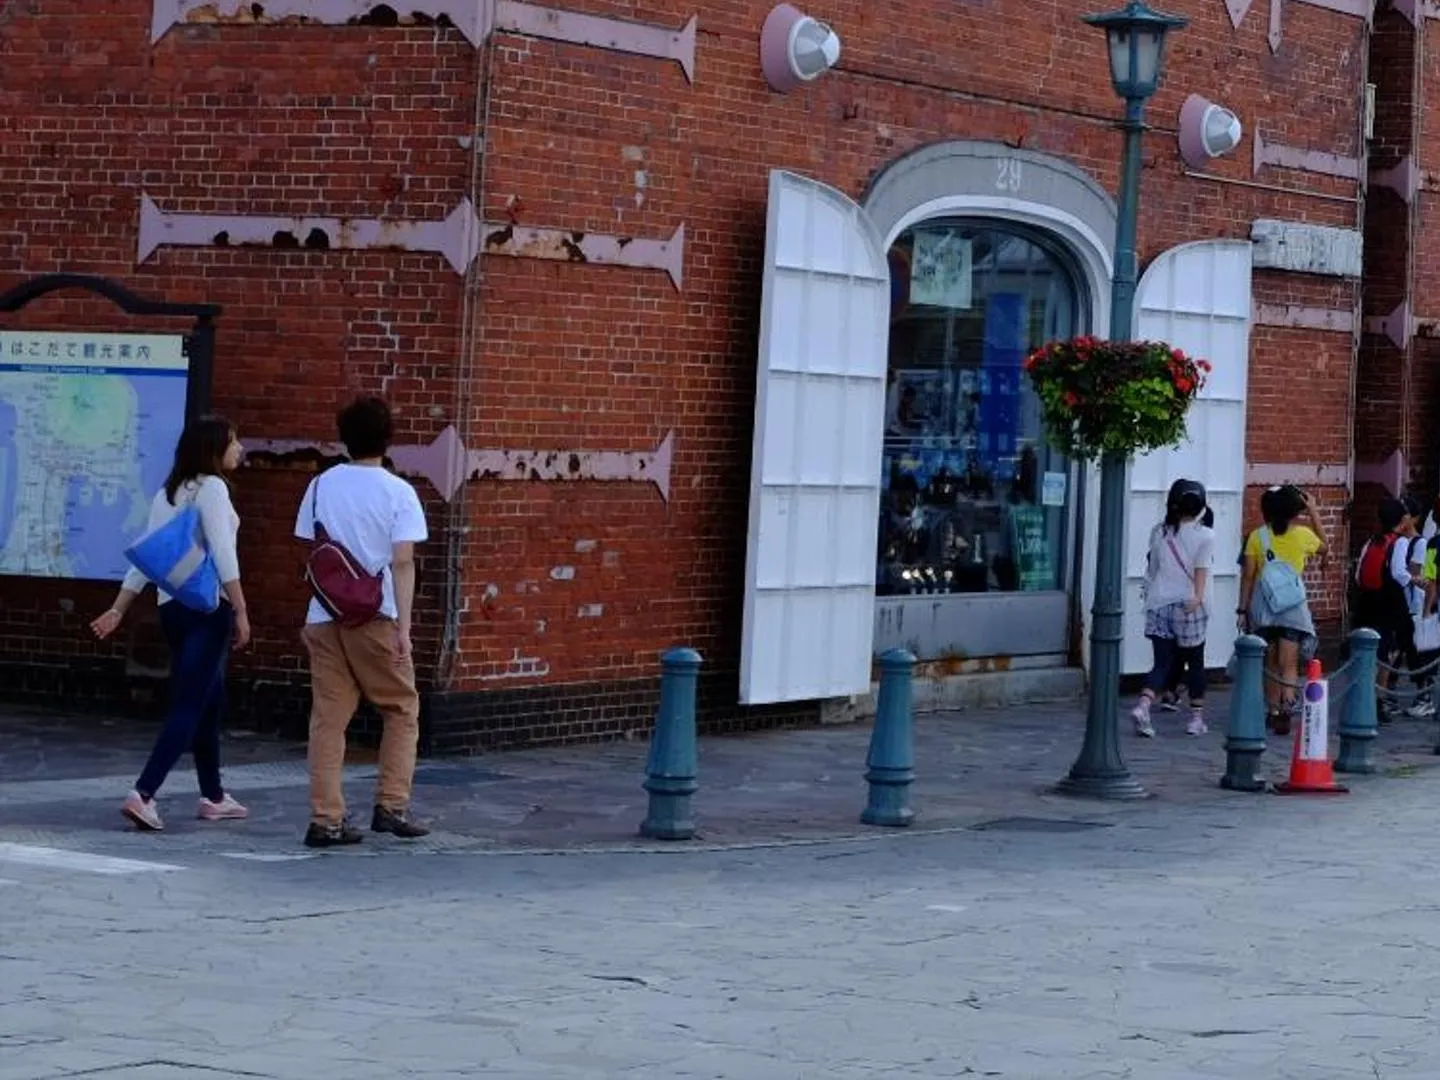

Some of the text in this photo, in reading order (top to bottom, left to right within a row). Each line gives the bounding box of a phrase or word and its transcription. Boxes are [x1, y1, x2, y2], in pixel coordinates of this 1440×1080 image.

[995, 157, 1022, 192] 29
[11, 341, 151, 360] はこだて観光案内
